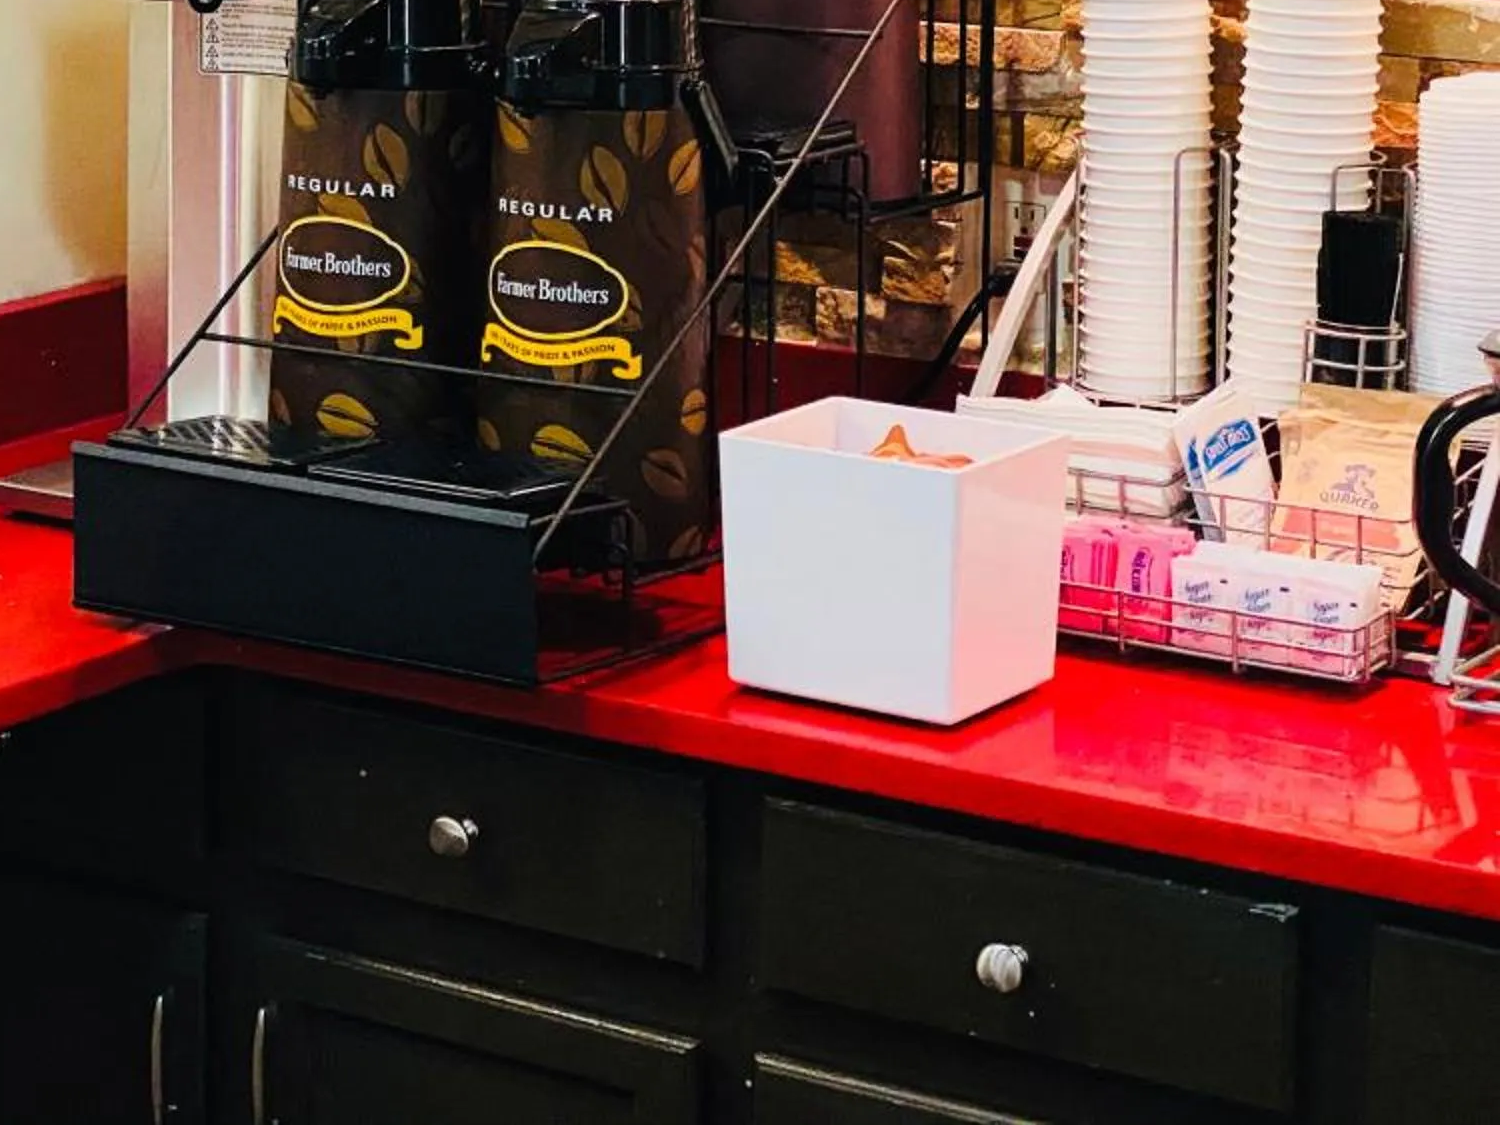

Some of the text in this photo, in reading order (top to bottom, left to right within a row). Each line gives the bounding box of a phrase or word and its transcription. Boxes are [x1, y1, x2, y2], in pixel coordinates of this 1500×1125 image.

[287, 175, 395, 198] REGULAR
[499, 198, 613, 223] REGULAR
[286, 246, 392, 277] Farmer Brothers
[497, 271, 609, 304] Farmer Brothers
[1319, 491, 1380, 511] QUAKER
